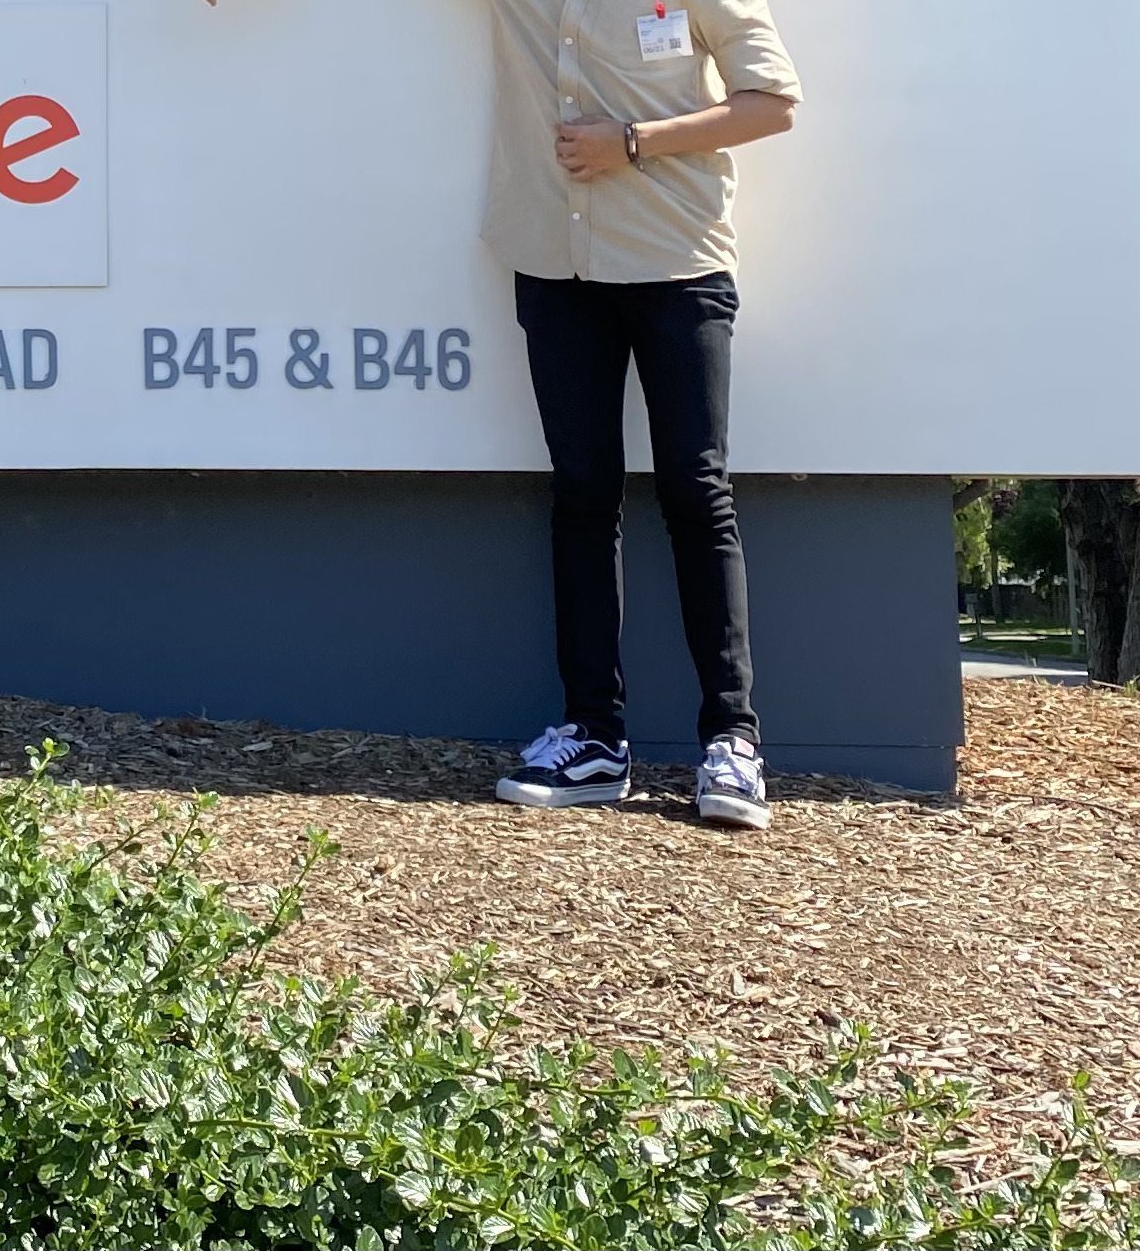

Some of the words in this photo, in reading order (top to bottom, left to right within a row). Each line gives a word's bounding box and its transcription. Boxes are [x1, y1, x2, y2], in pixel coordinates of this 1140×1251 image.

[143, 327, 260, 391] B45
[284, 327, 335, 391] &
[352, 327, 472, 392] B46
